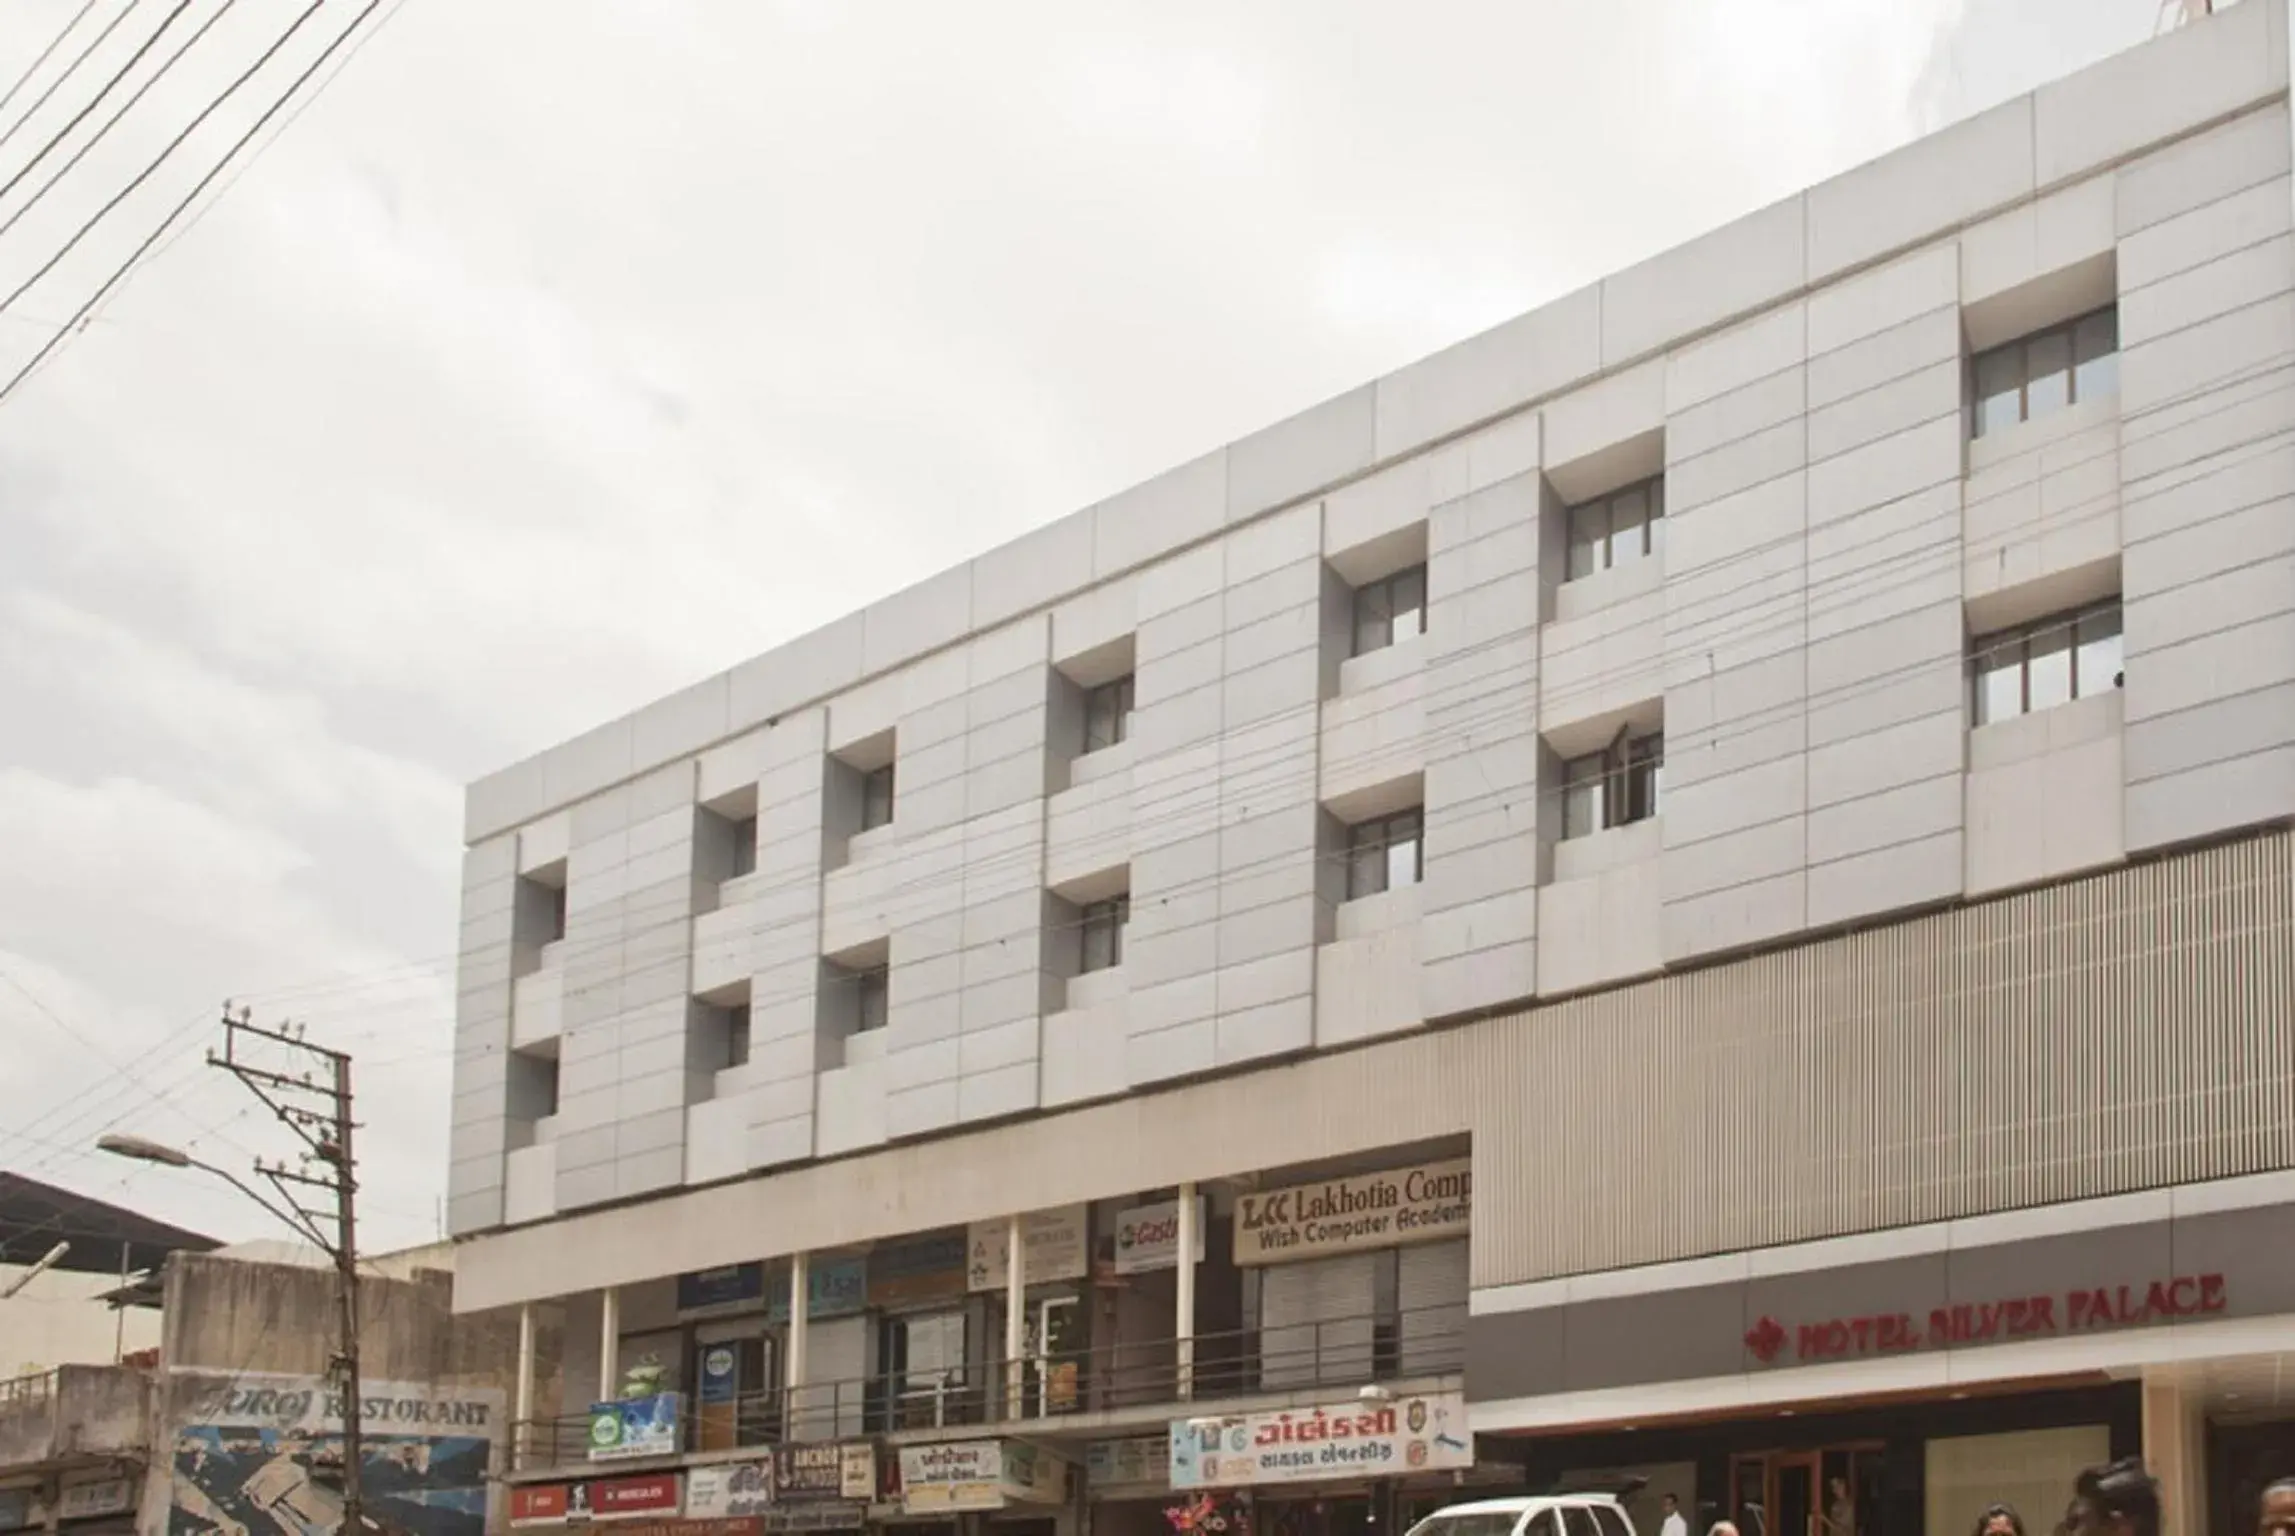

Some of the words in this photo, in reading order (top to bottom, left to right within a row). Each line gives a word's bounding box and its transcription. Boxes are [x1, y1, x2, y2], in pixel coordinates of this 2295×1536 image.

[1296, 1180, 1398, 1222] Lakhotia
[1405, 1170, 1473, 1203] Comp
[1305, 1214, 1390, 1243] Computer
[1396, 1202, 1473, 1233] Academ
[1796, 1313, 1922, 1358] HOTEL
[1928, 1296, 2056, 1344] SILVER
[2067, 1273, 2227, 1330] PALACE
[323, 1391, 491, 1426] RSTORANT
